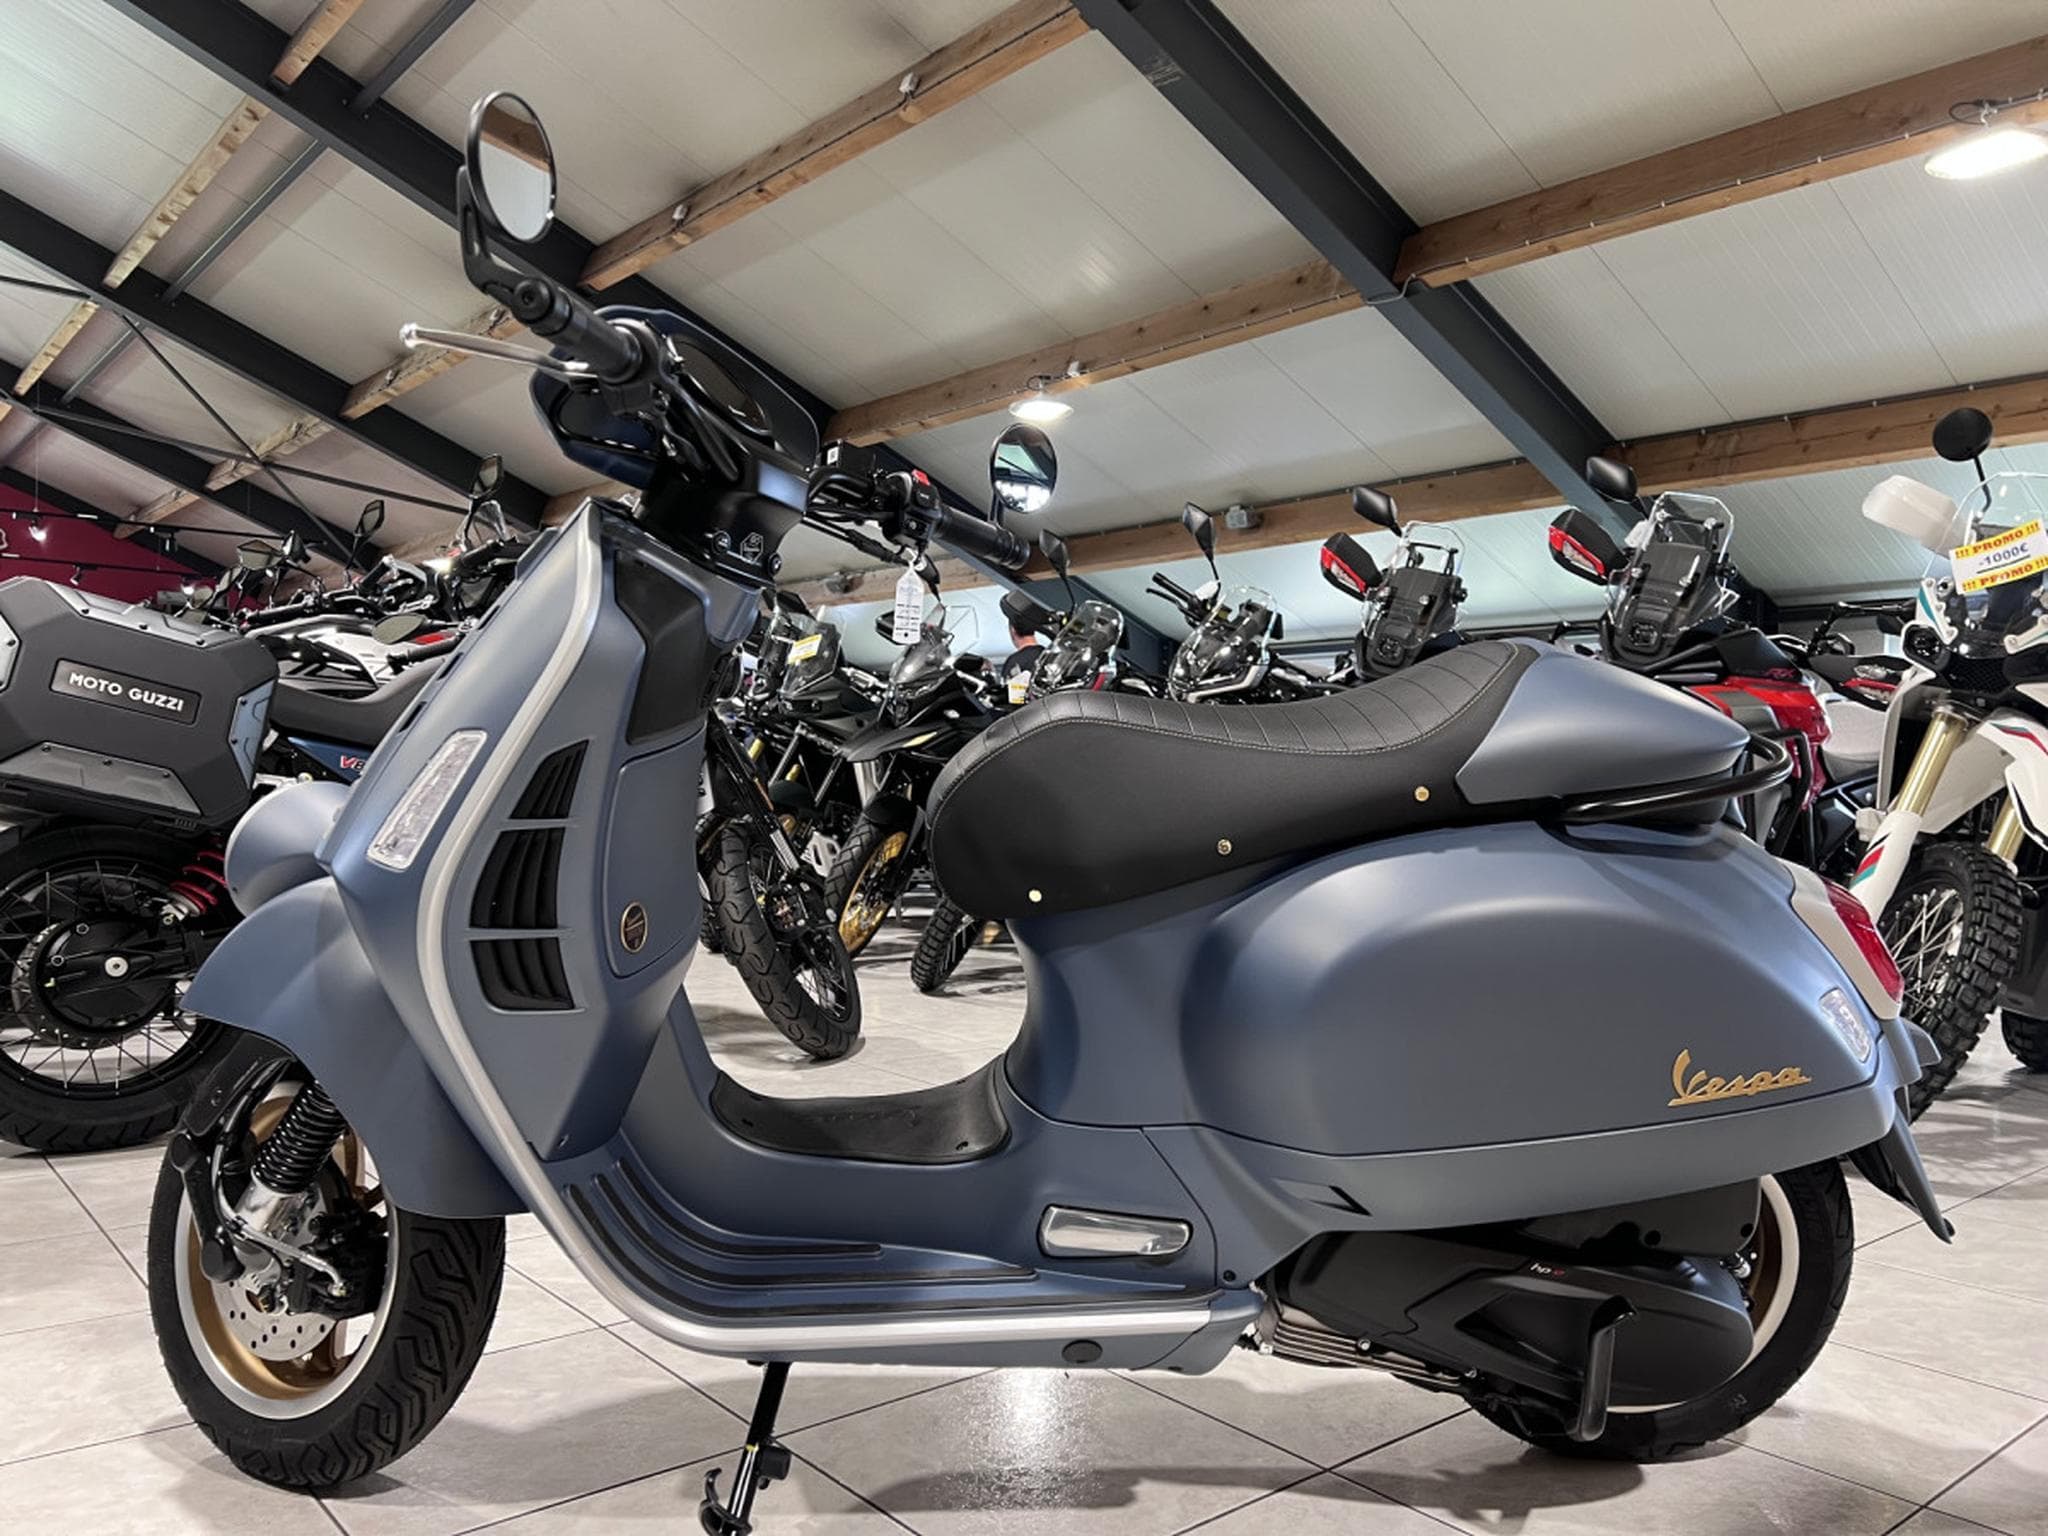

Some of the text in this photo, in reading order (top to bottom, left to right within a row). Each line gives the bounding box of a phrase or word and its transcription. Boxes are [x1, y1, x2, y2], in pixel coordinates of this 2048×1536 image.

[1973, 529, 2024, 554] PROMO
[69, 672, 184, 712] MOTO GUZZI
[1667, 1049, 1812, 1107] Vespa
